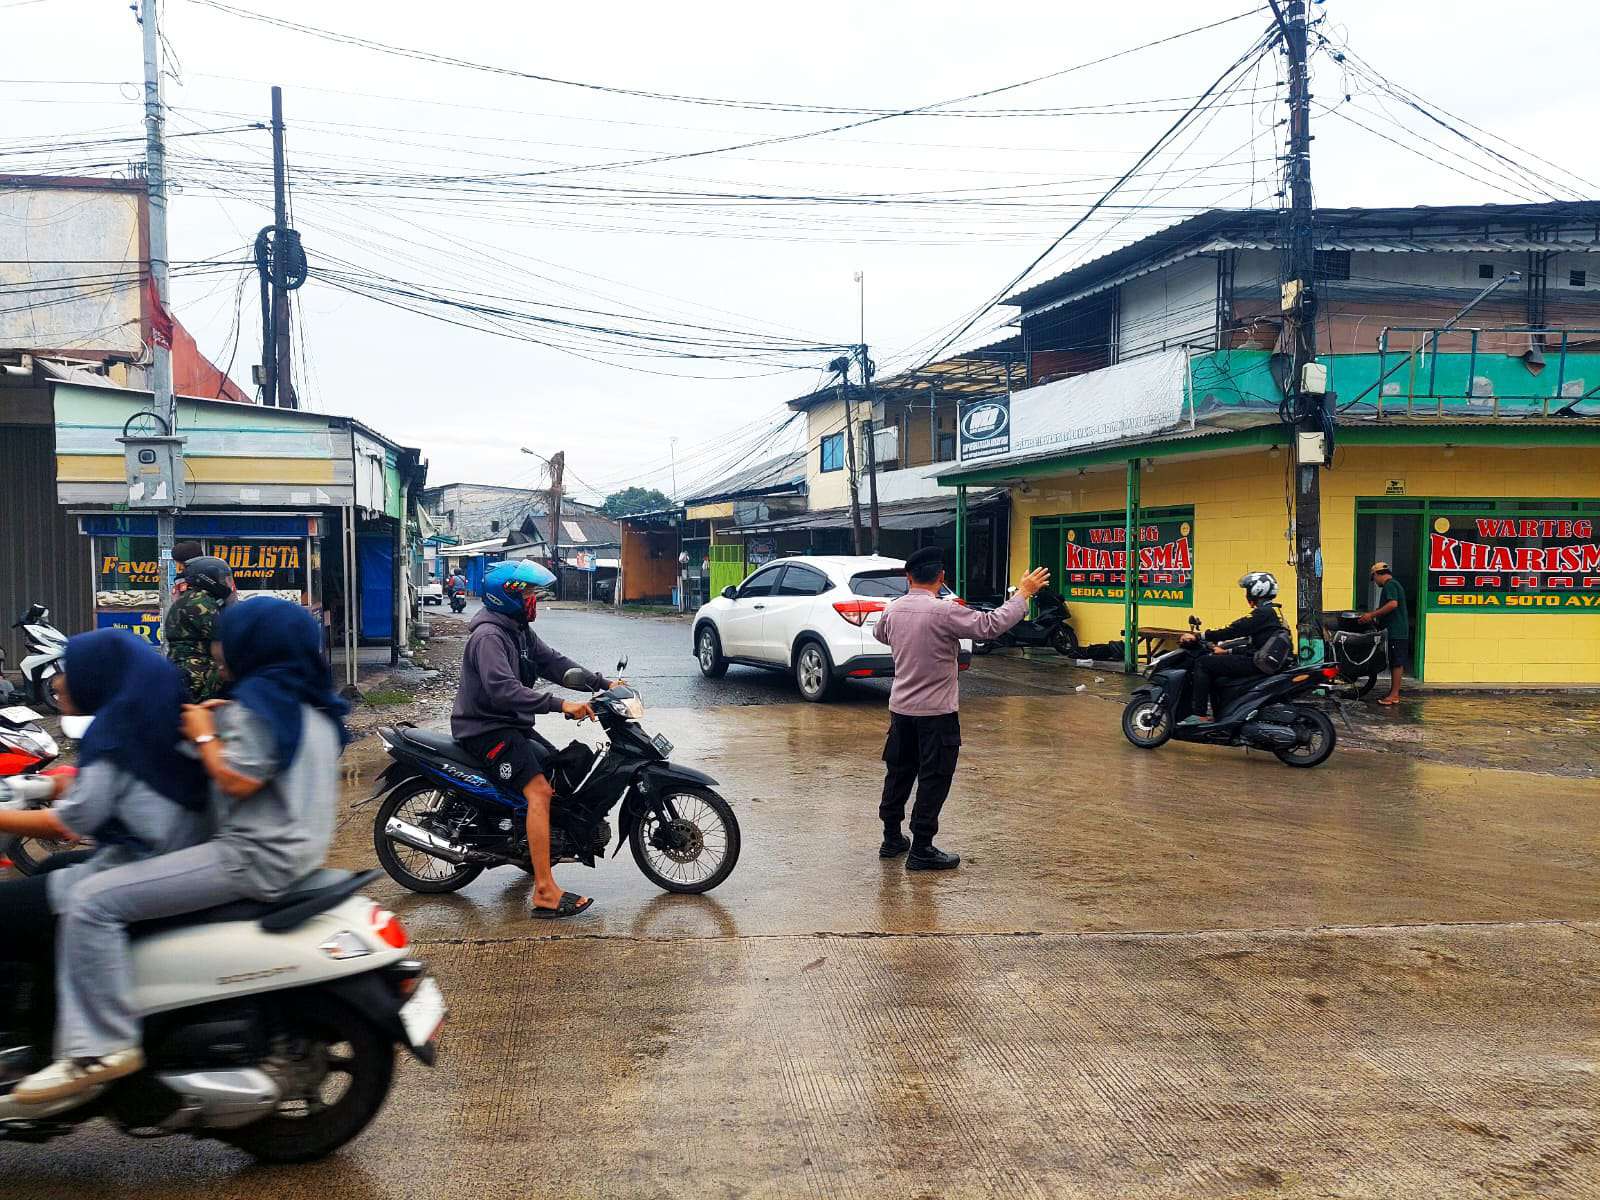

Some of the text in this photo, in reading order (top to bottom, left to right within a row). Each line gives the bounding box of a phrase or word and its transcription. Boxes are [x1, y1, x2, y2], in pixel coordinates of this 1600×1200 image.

[1476, 519, 1592, 538] WARTEG
[234, 569, 275, 578] MANIS
[1070, 587, 1184, 600] SEDIA SO AYAM
[1438, 594, 1500, 606] SEDIA
[1505, 595, 1561, 606] SOTO
